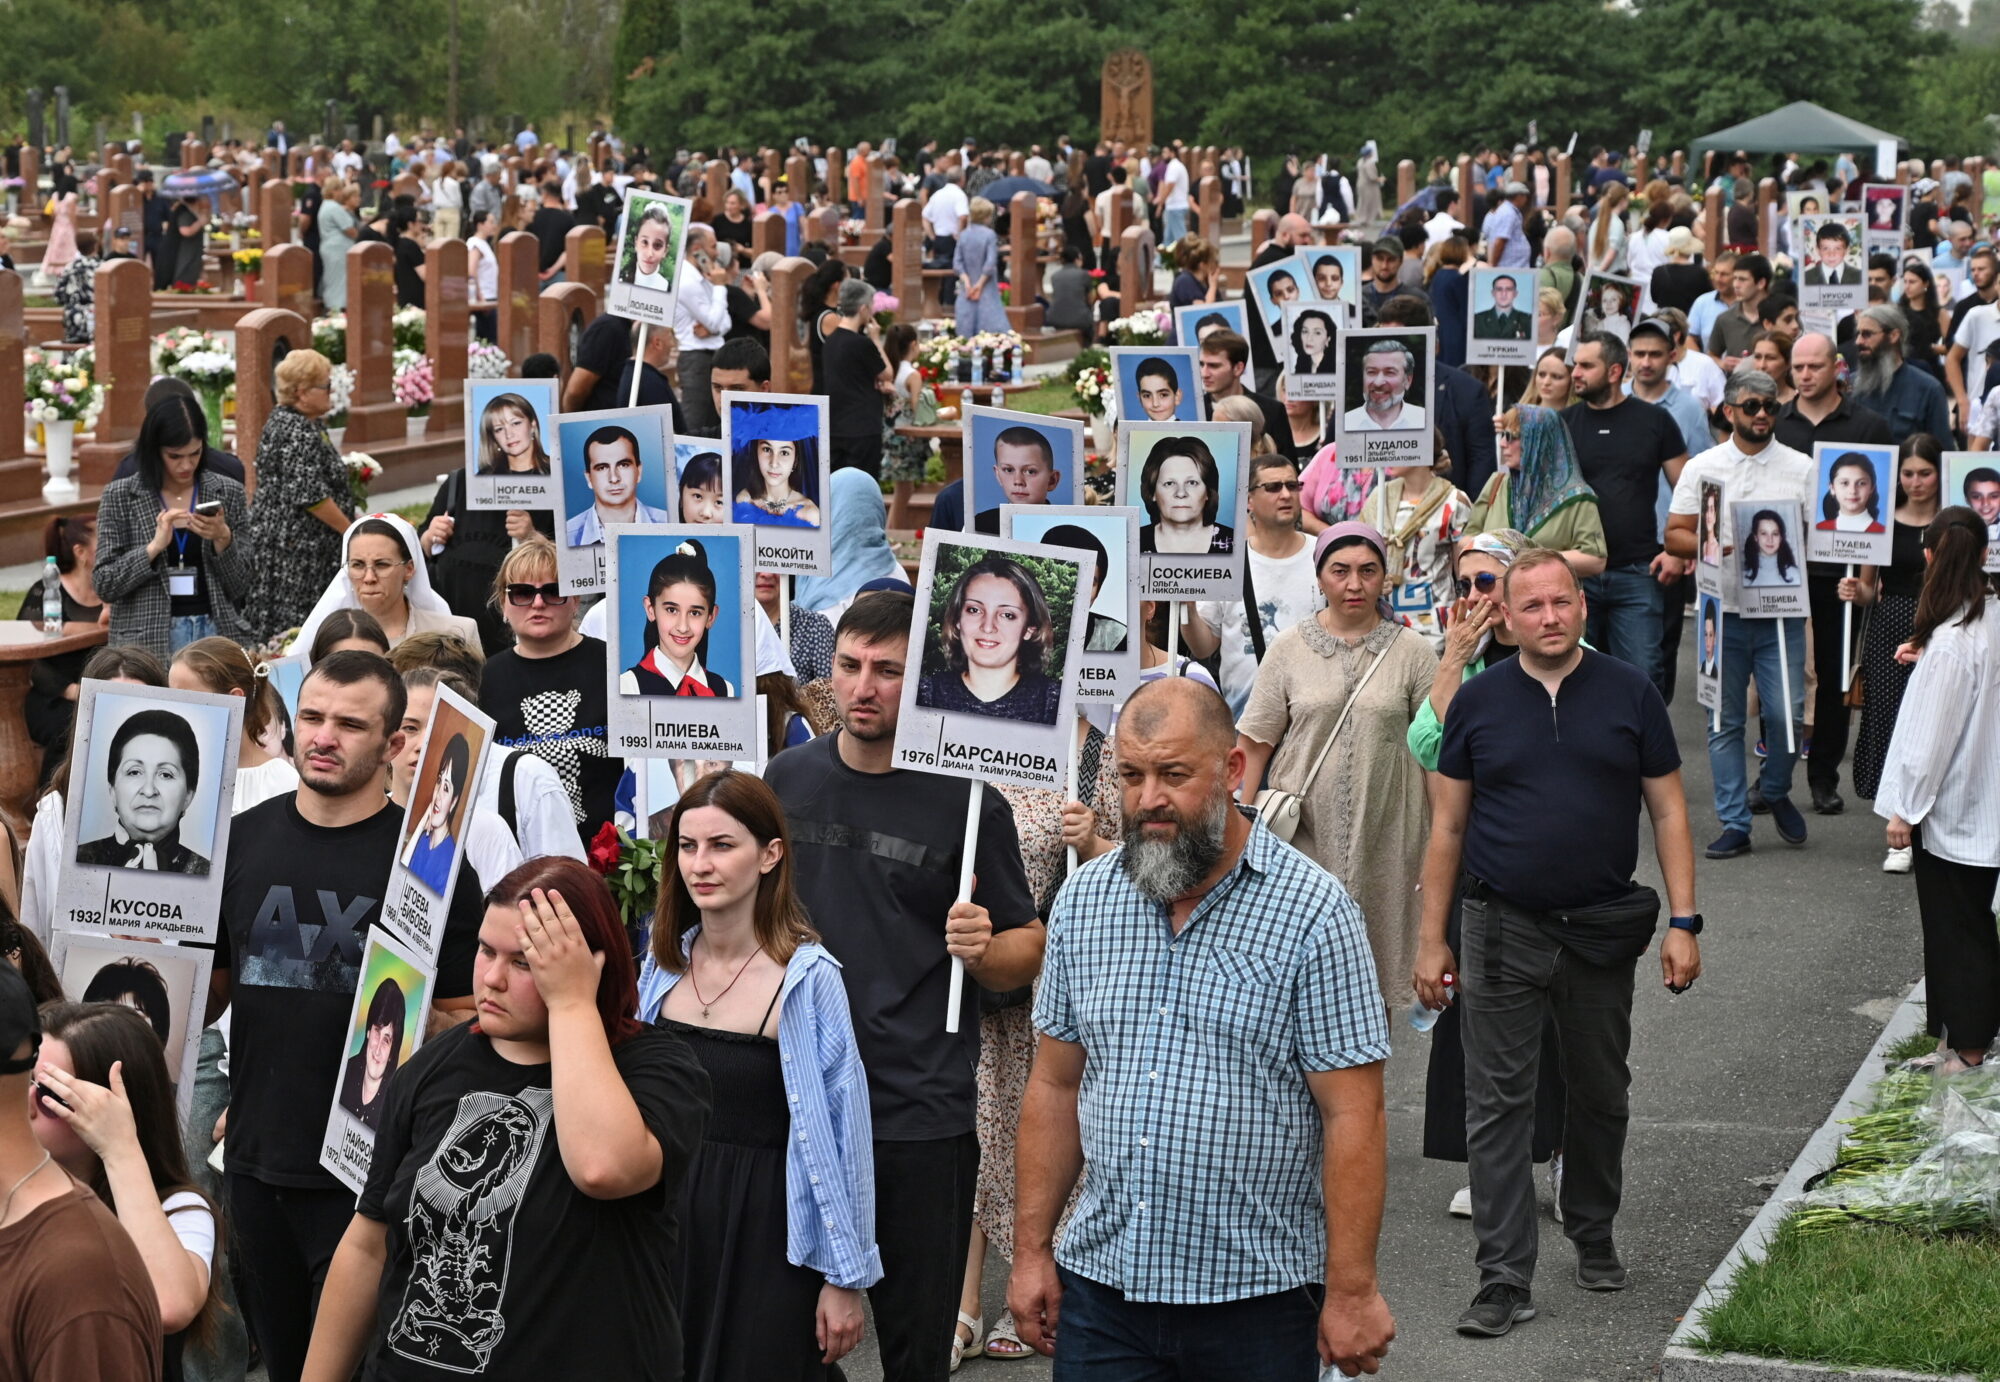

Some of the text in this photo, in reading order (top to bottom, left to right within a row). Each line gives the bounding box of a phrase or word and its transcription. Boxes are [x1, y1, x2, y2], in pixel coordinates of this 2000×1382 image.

[1367, 440, 1418, 450] ХУДАЛОВ
[1344, 455, 1363, 463] 1951
[497, 486, 546, 494] НОГАЕВА
[1835, 540, 1872, 549] ТУАЕВА
[758, 546, 814, 561] КОКОЙТИ
[759, 560, 818, 571] БЕЛЛА МАРТИЕВНА
[1152, 567, 1232, 579] СОСКИЕВА
[570, 577, 595, 588] 1969
[1077, 688, 1115, 696] СЬЕВНА
[498, 725, 607, 748] bdivisione
[654, 723, 720, 738] ПЛИЕВА
[619, 736, 648, 748] 1993
[656, 740, 743, 752] АЛАНА ВАЖАЕВНА
[901, 749, 935, 766] 1976
[943, 742, 1058, 773] КАРСАНОВА
[941, 759, 1055, 783] ДИАНА ТАЙМУРАЗОВНА
[403, 882, 430, 916] ЦГОЕВА
[69, 908, 102, 924] 1932
[110, 898, 183, 920] КУСОВА
[108, 917, 204, 935] МАРИЯ АРКАДЬЕВНА
[400, 902, 432, 940] -БИБОЕВА
[325, 1145, 339, 1164] 1972
